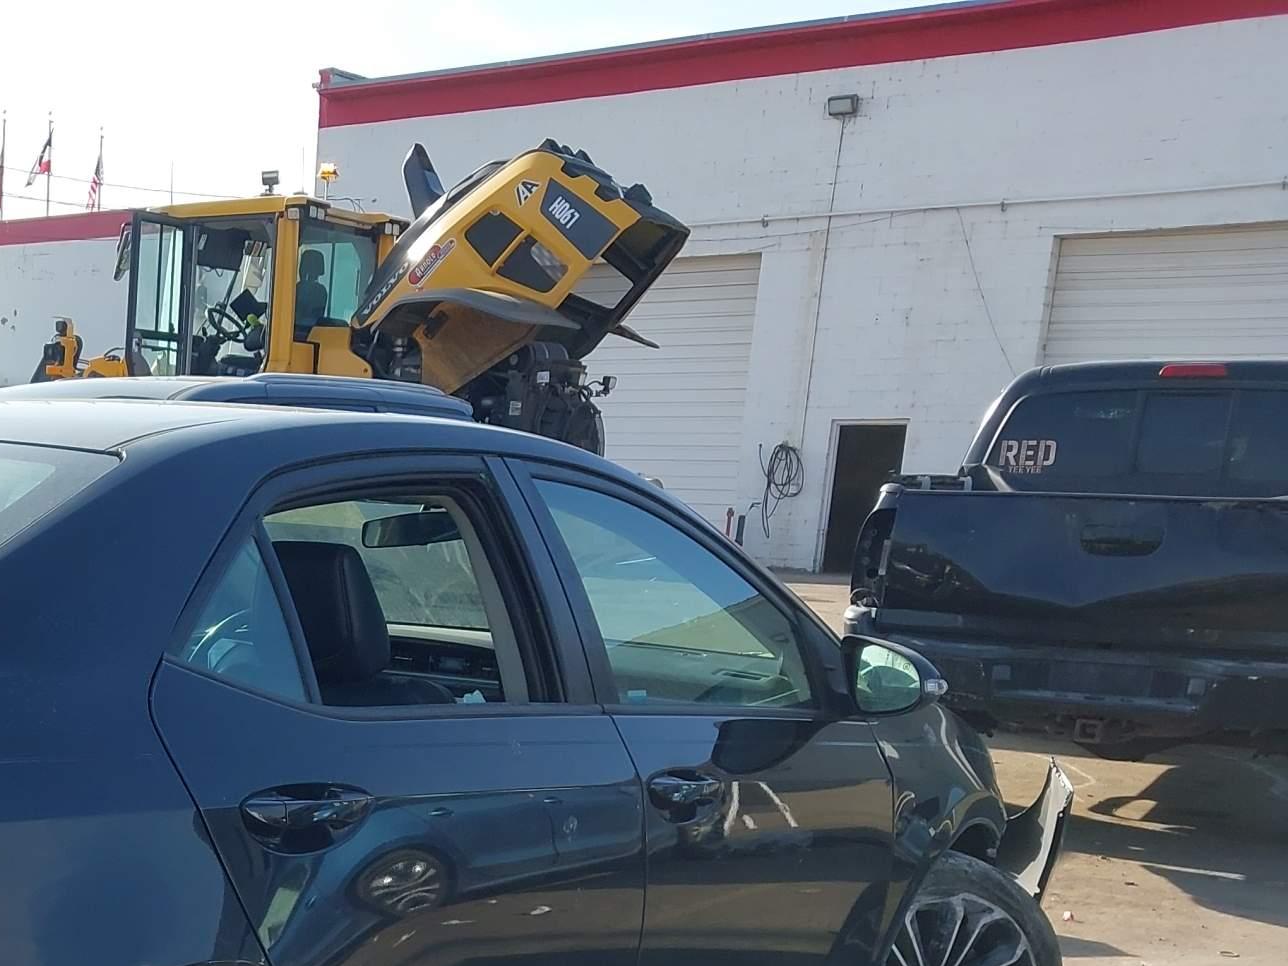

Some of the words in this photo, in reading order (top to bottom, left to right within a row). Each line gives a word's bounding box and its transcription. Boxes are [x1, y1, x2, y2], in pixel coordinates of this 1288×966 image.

[549, 196, 580, 229] H061
[361, 261, 409, 315] VOLVO
[999, 439, 1057, 466] RED
